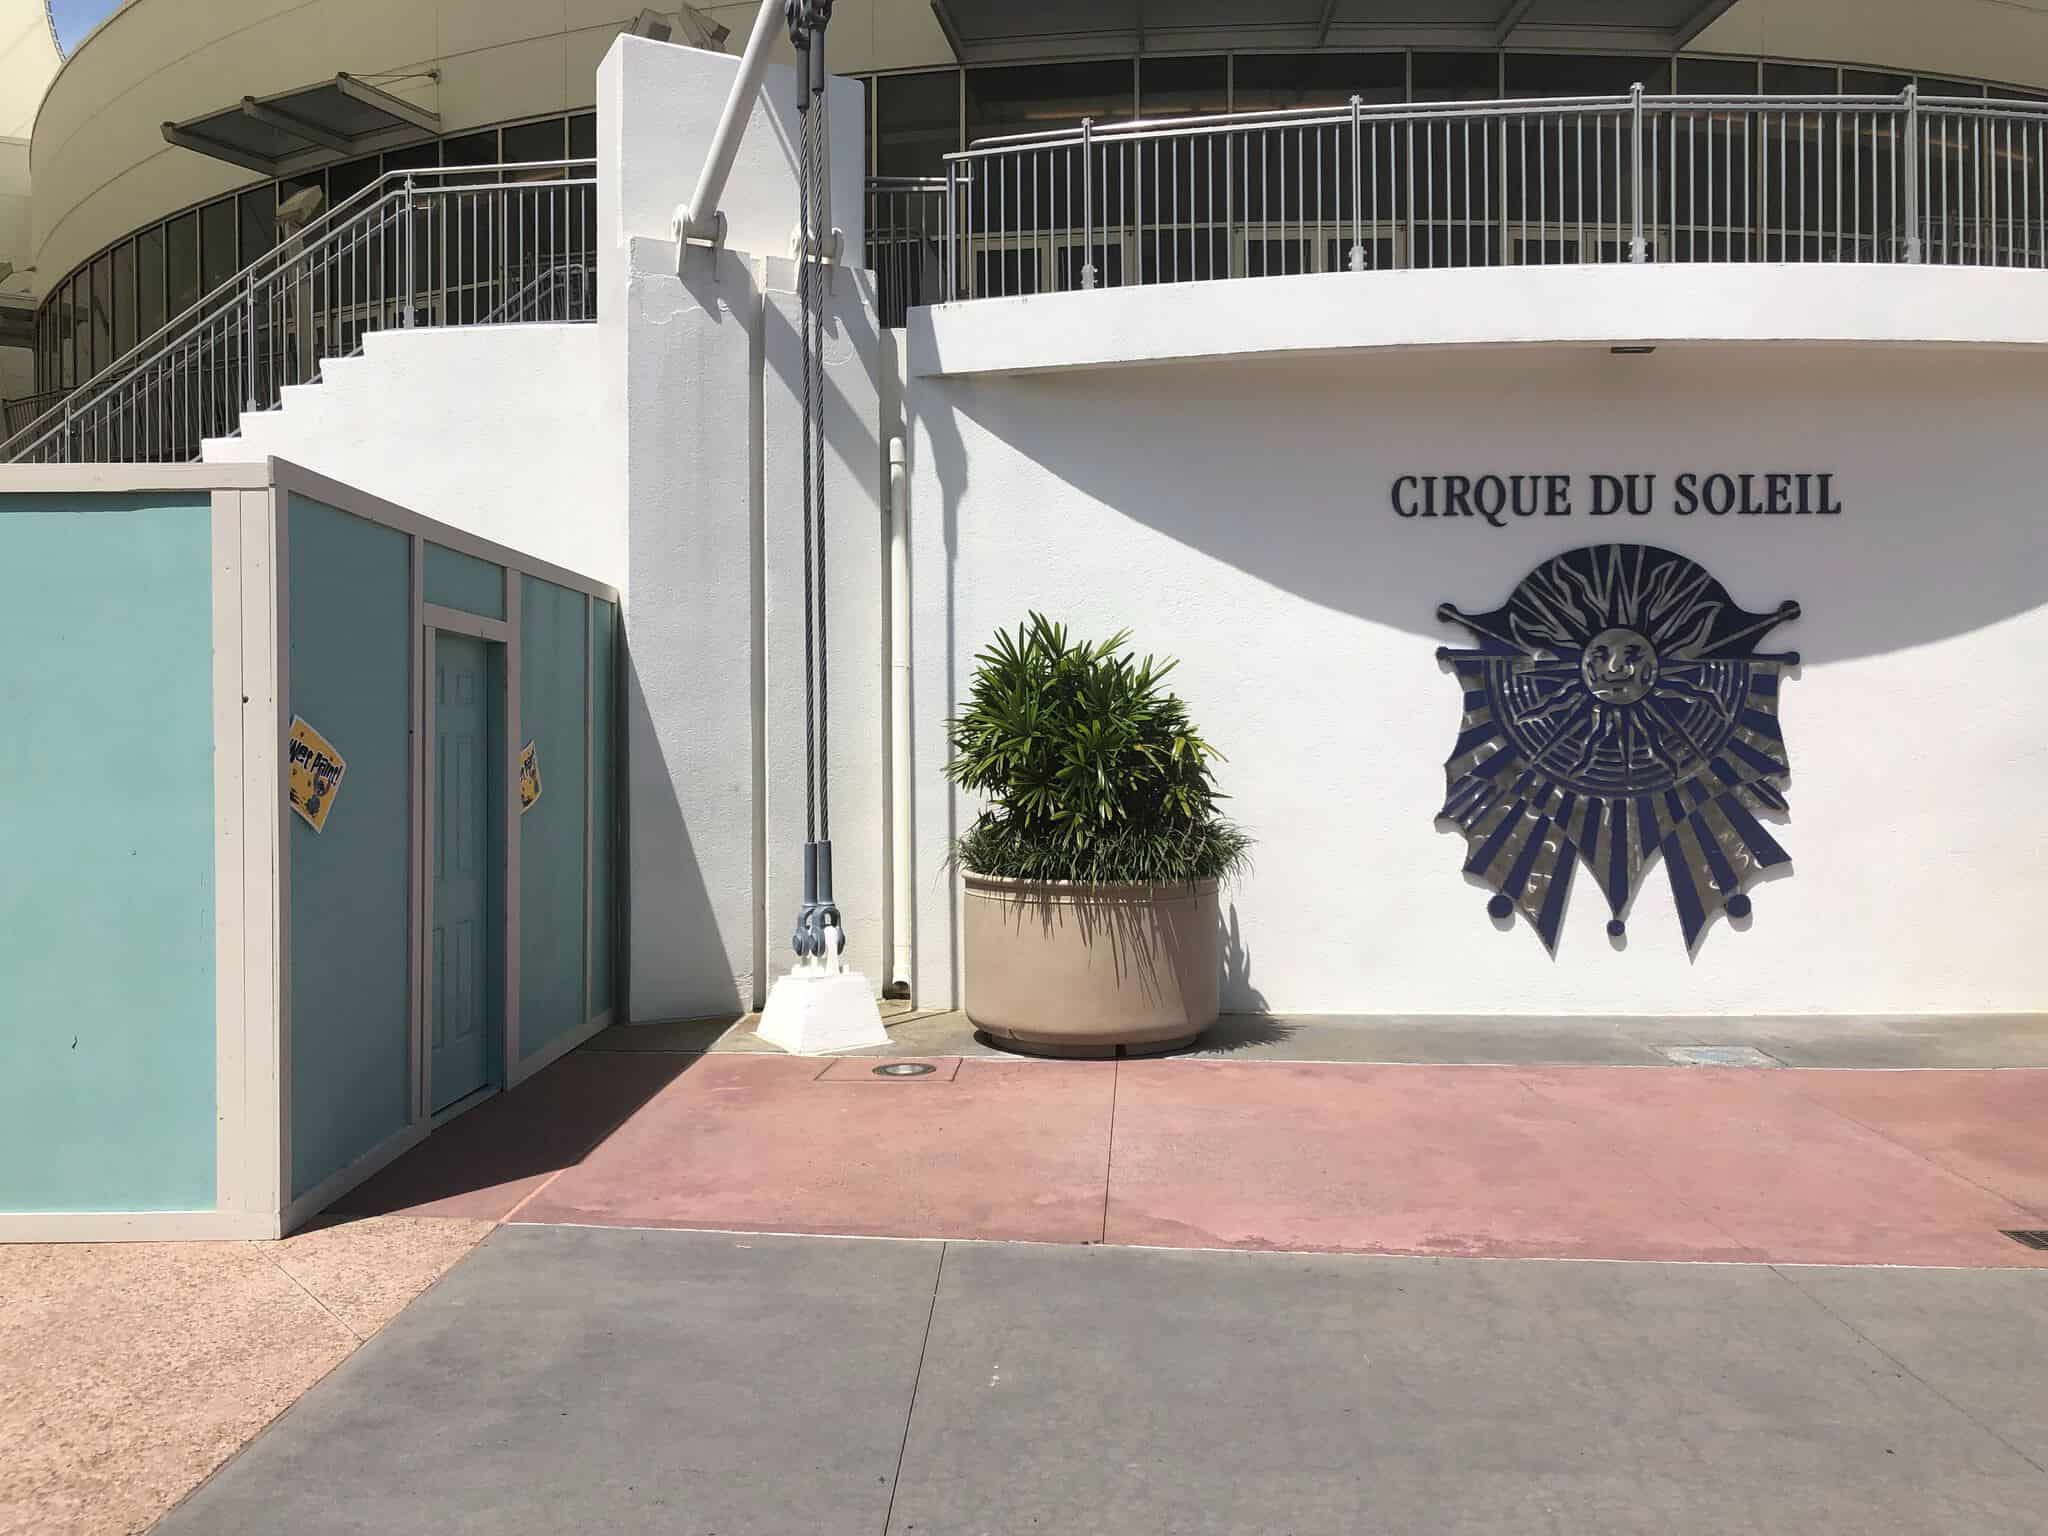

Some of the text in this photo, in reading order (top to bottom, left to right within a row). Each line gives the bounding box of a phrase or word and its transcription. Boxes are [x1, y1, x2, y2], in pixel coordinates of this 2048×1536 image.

[1391, 473, 1841, 527] CIRQUE DU SOLEIL
[289, 738, 313, 769] Wet
